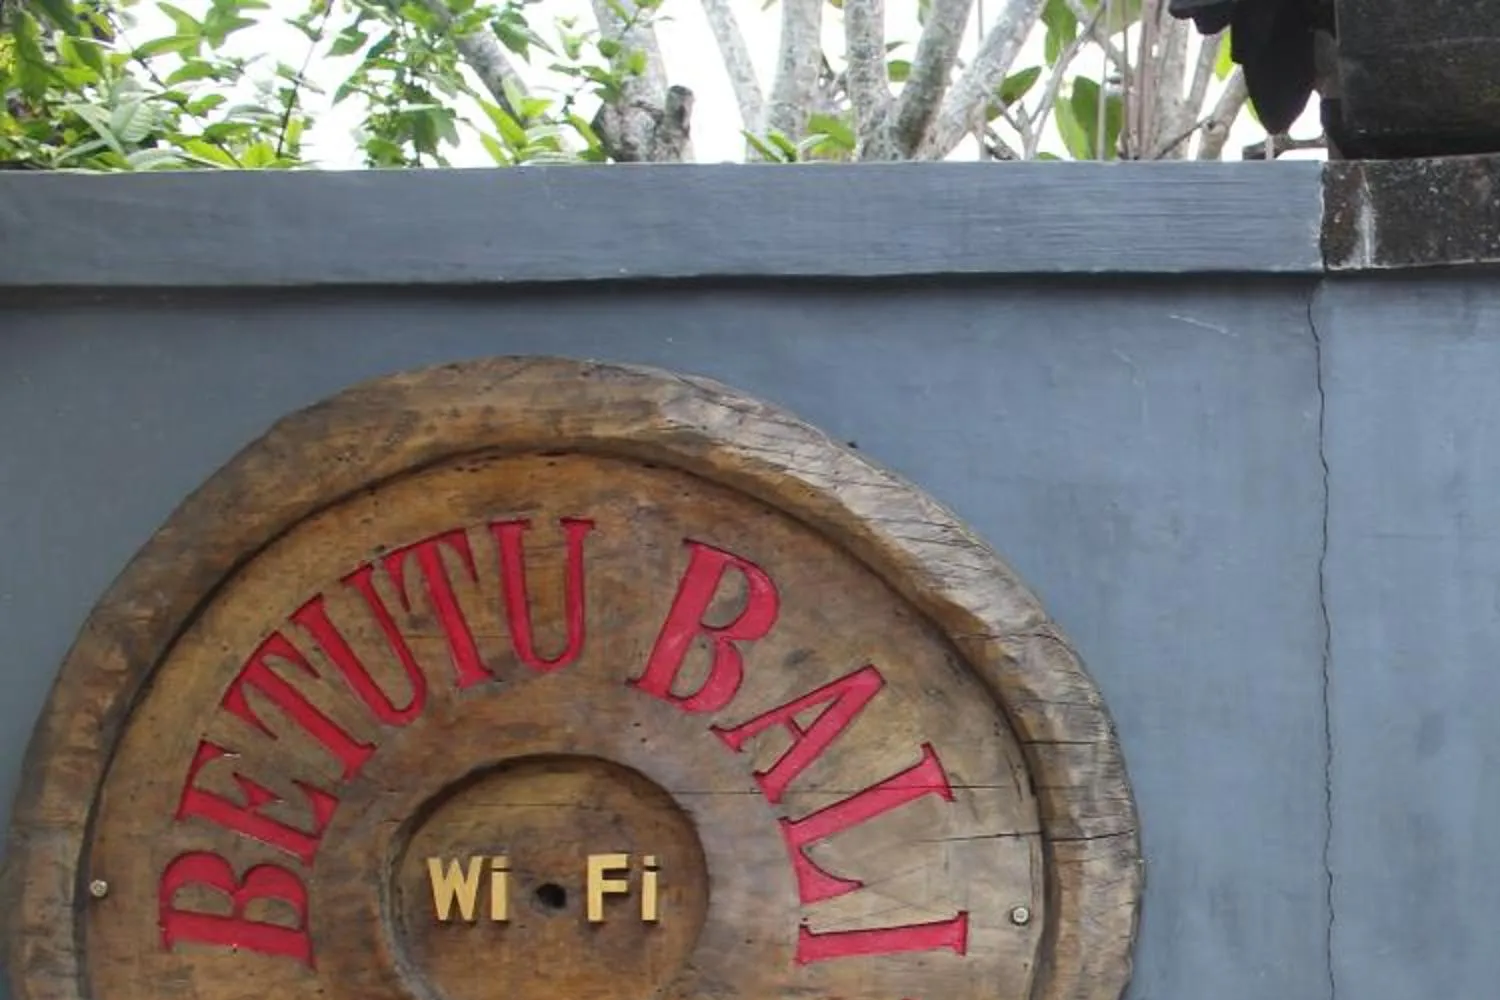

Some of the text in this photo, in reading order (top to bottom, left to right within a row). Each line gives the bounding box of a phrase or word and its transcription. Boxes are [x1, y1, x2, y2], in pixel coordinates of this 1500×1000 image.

[160, 517, 970, 968] BETUTU BALI
[426, 852, 658, 922] Wi Fi
